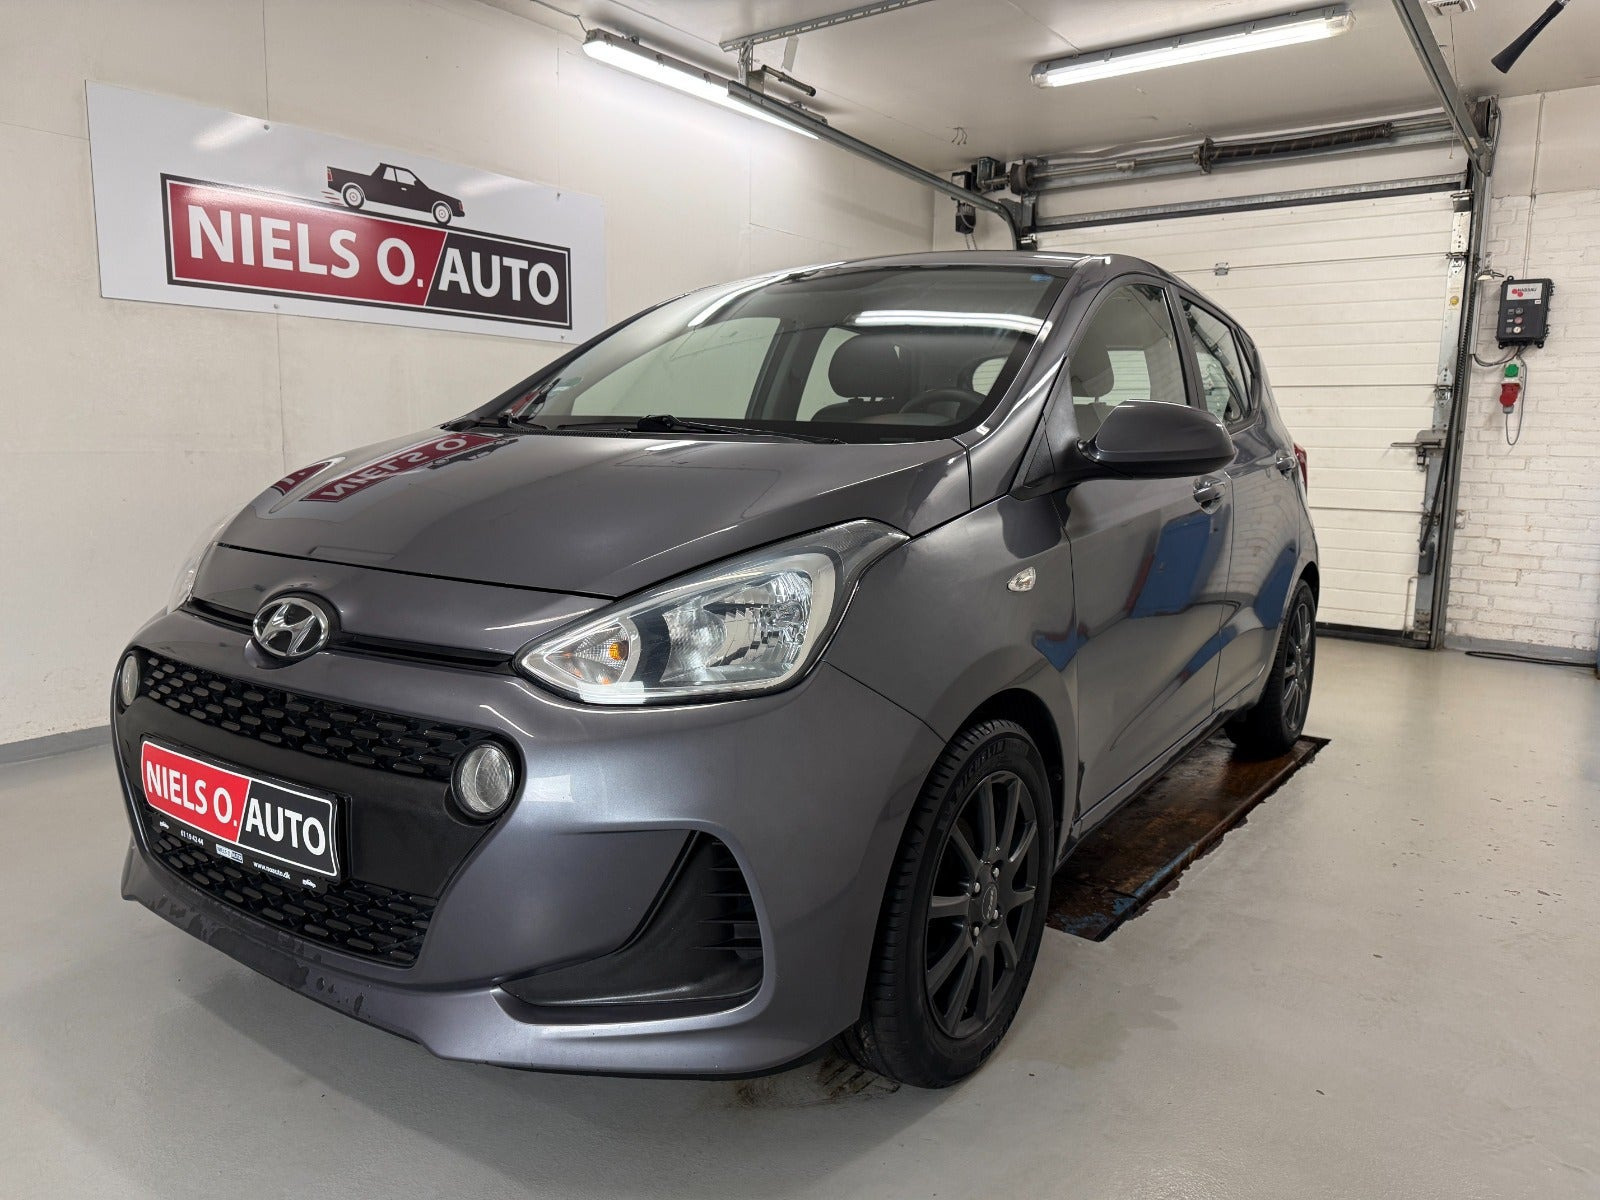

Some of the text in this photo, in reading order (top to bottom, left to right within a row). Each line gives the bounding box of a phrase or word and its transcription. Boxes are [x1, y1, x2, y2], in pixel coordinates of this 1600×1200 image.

[187, 204, 560, 306] NIELS O. AUTO
[146, 760, 326, 856] NIELS O. AUTO
